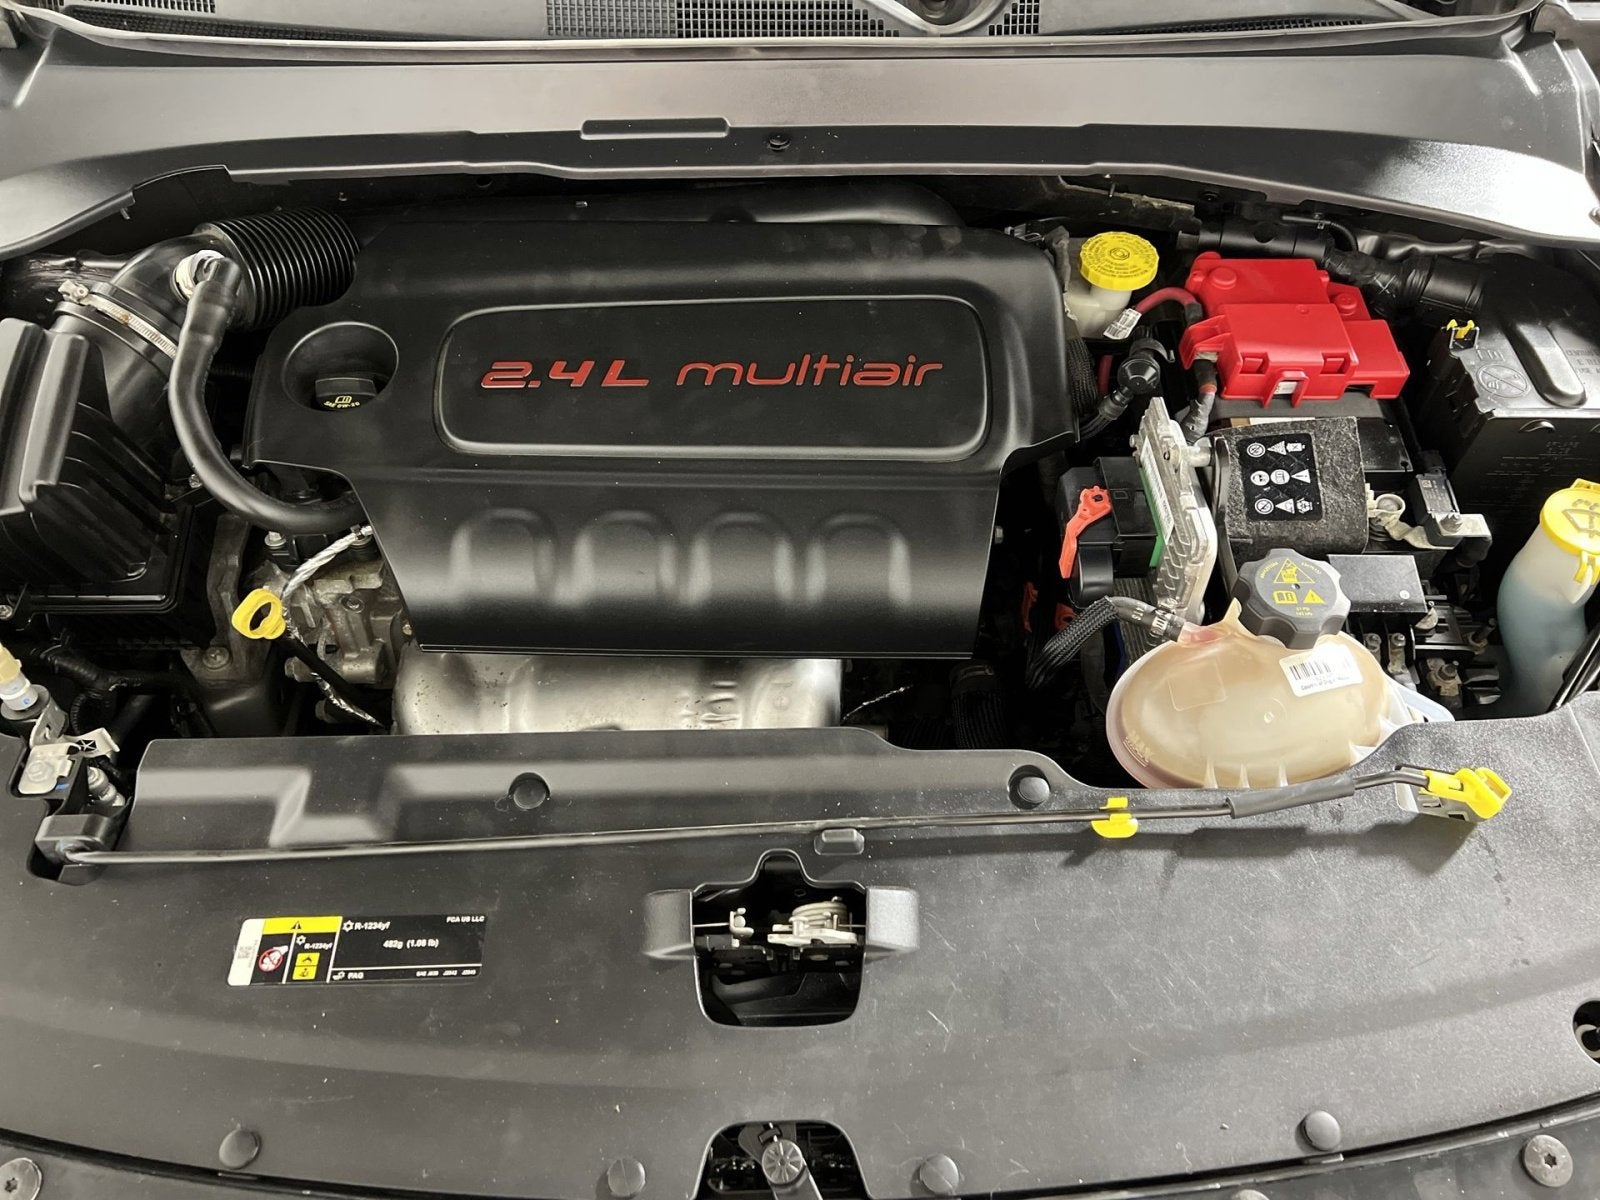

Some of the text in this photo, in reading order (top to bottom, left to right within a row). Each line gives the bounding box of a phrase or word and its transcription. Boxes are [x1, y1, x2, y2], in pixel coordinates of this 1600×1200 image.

[676, 354, 943, 386] multiair
[471, 915, 485, 923] LLC
[354, 921, 391, 931] R-1234yf
